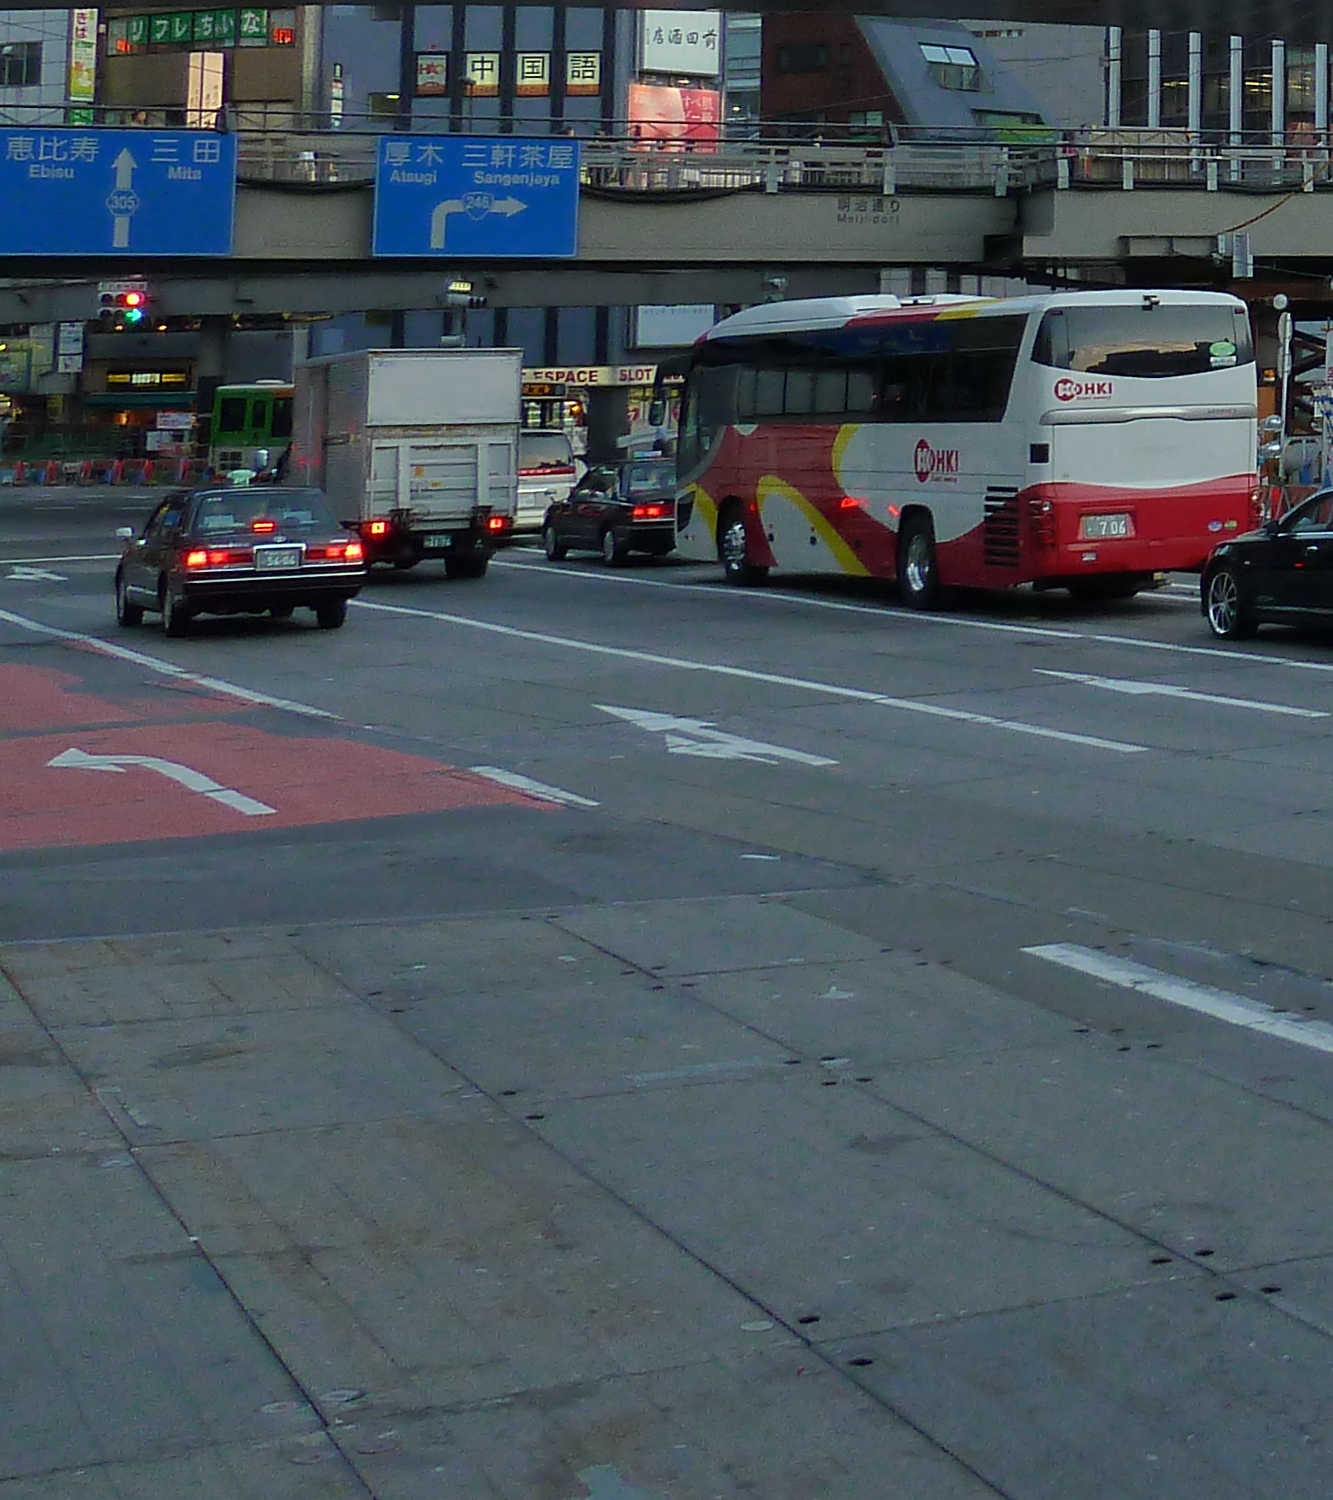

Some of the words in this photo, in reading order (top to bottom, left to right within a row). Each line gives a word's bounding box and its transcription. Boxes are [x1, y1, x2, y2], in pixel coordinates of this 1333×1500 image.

[5, 136, 99, 162] 恵比寿
[151, 139, 220, 163] 三田
[384, 142, 444, 167] 厚木
[461, 144, 573, 169] 三軒茶屋
[29, 164, 74, 179] Ebisu
[168, 166, 201, 180] Mita
[390, 170, 437, 185] Atsugi
[474, 171, 559, 187] Sangenjaya
[110, 195, 135, 209] 305
[465, 196, 489, 209] 246
[620, 368, 652, 381] SLOT
